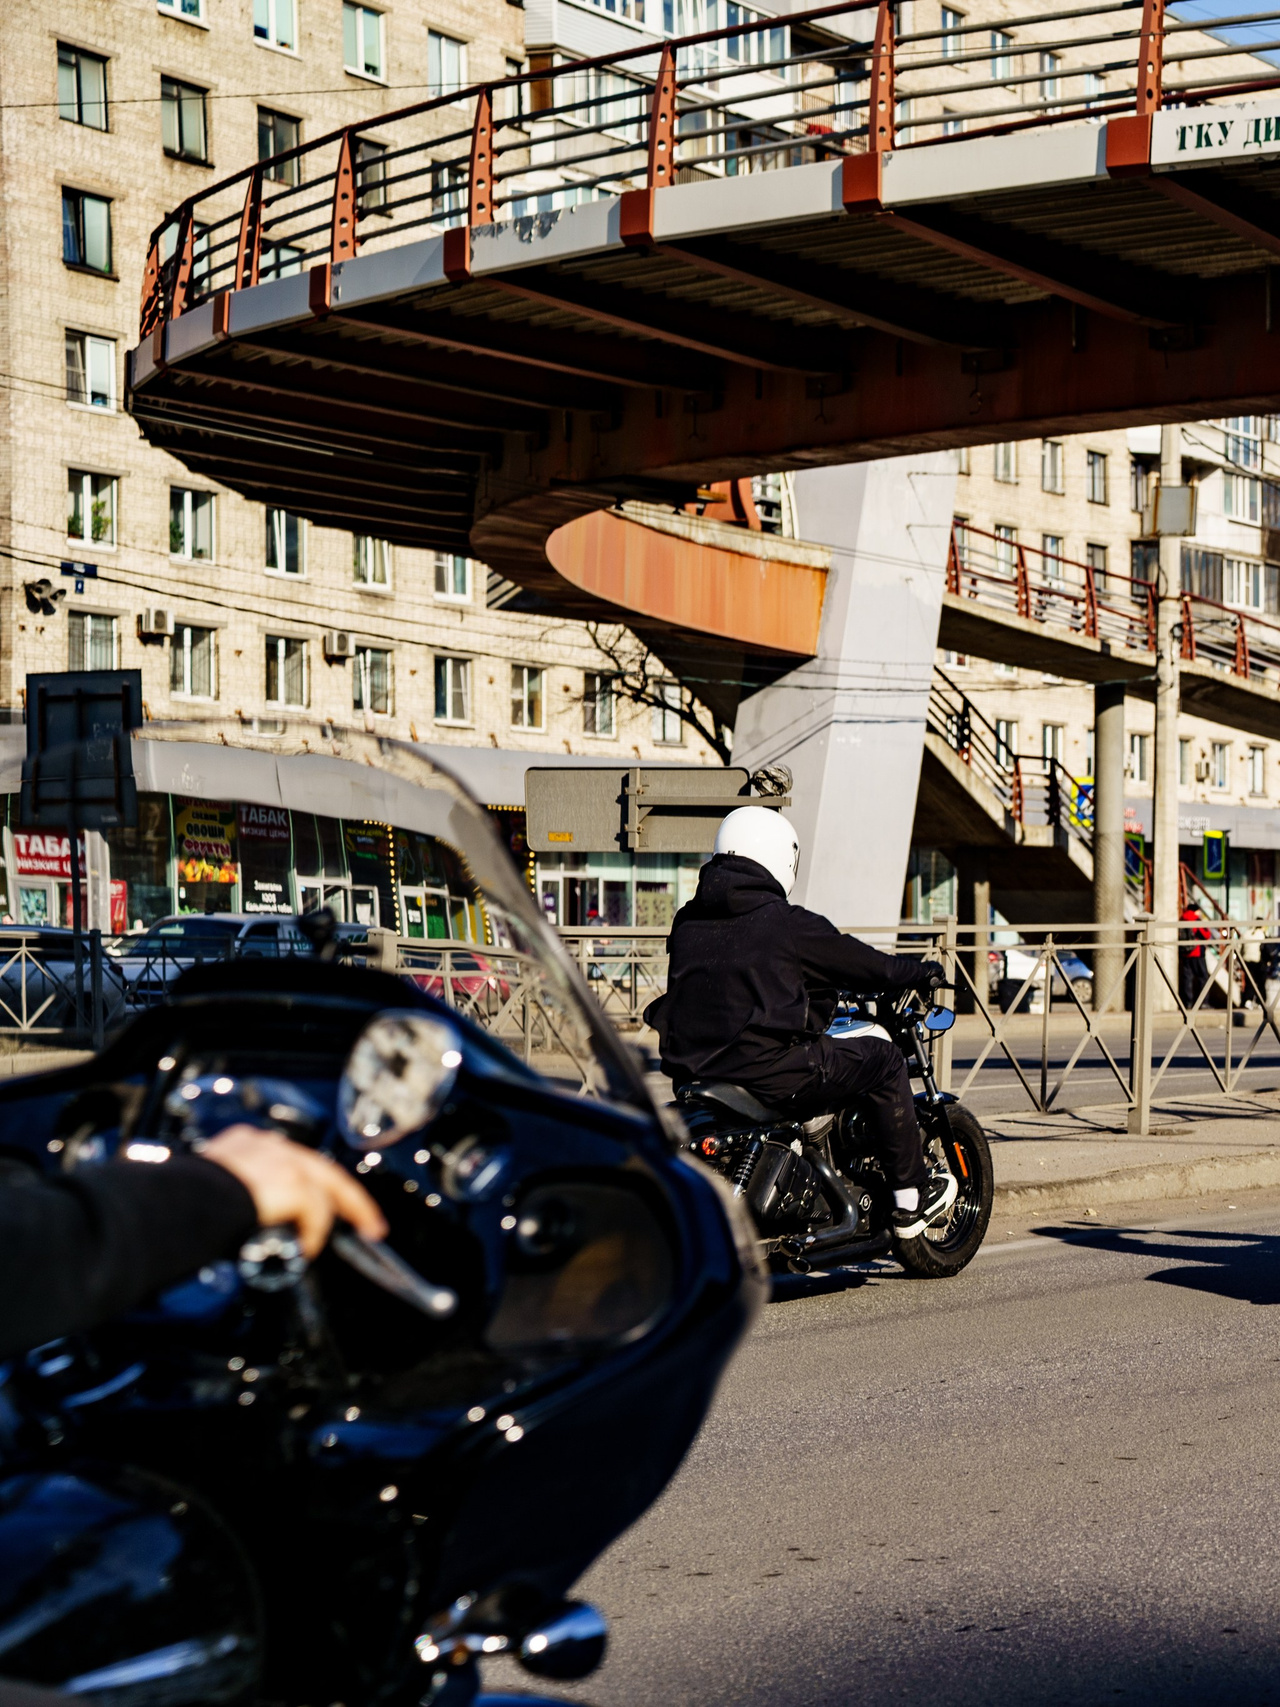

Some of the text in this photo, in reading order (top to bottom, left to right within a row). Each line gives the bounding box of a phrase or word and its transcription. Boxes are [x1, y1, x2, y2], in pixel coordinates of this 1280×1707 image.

[240, 805, 288, 827] ТАБАК
[269, 829, 290, 839] ЦЕНЫ
[182, 839, 231, 860] ФРУКТЫ
